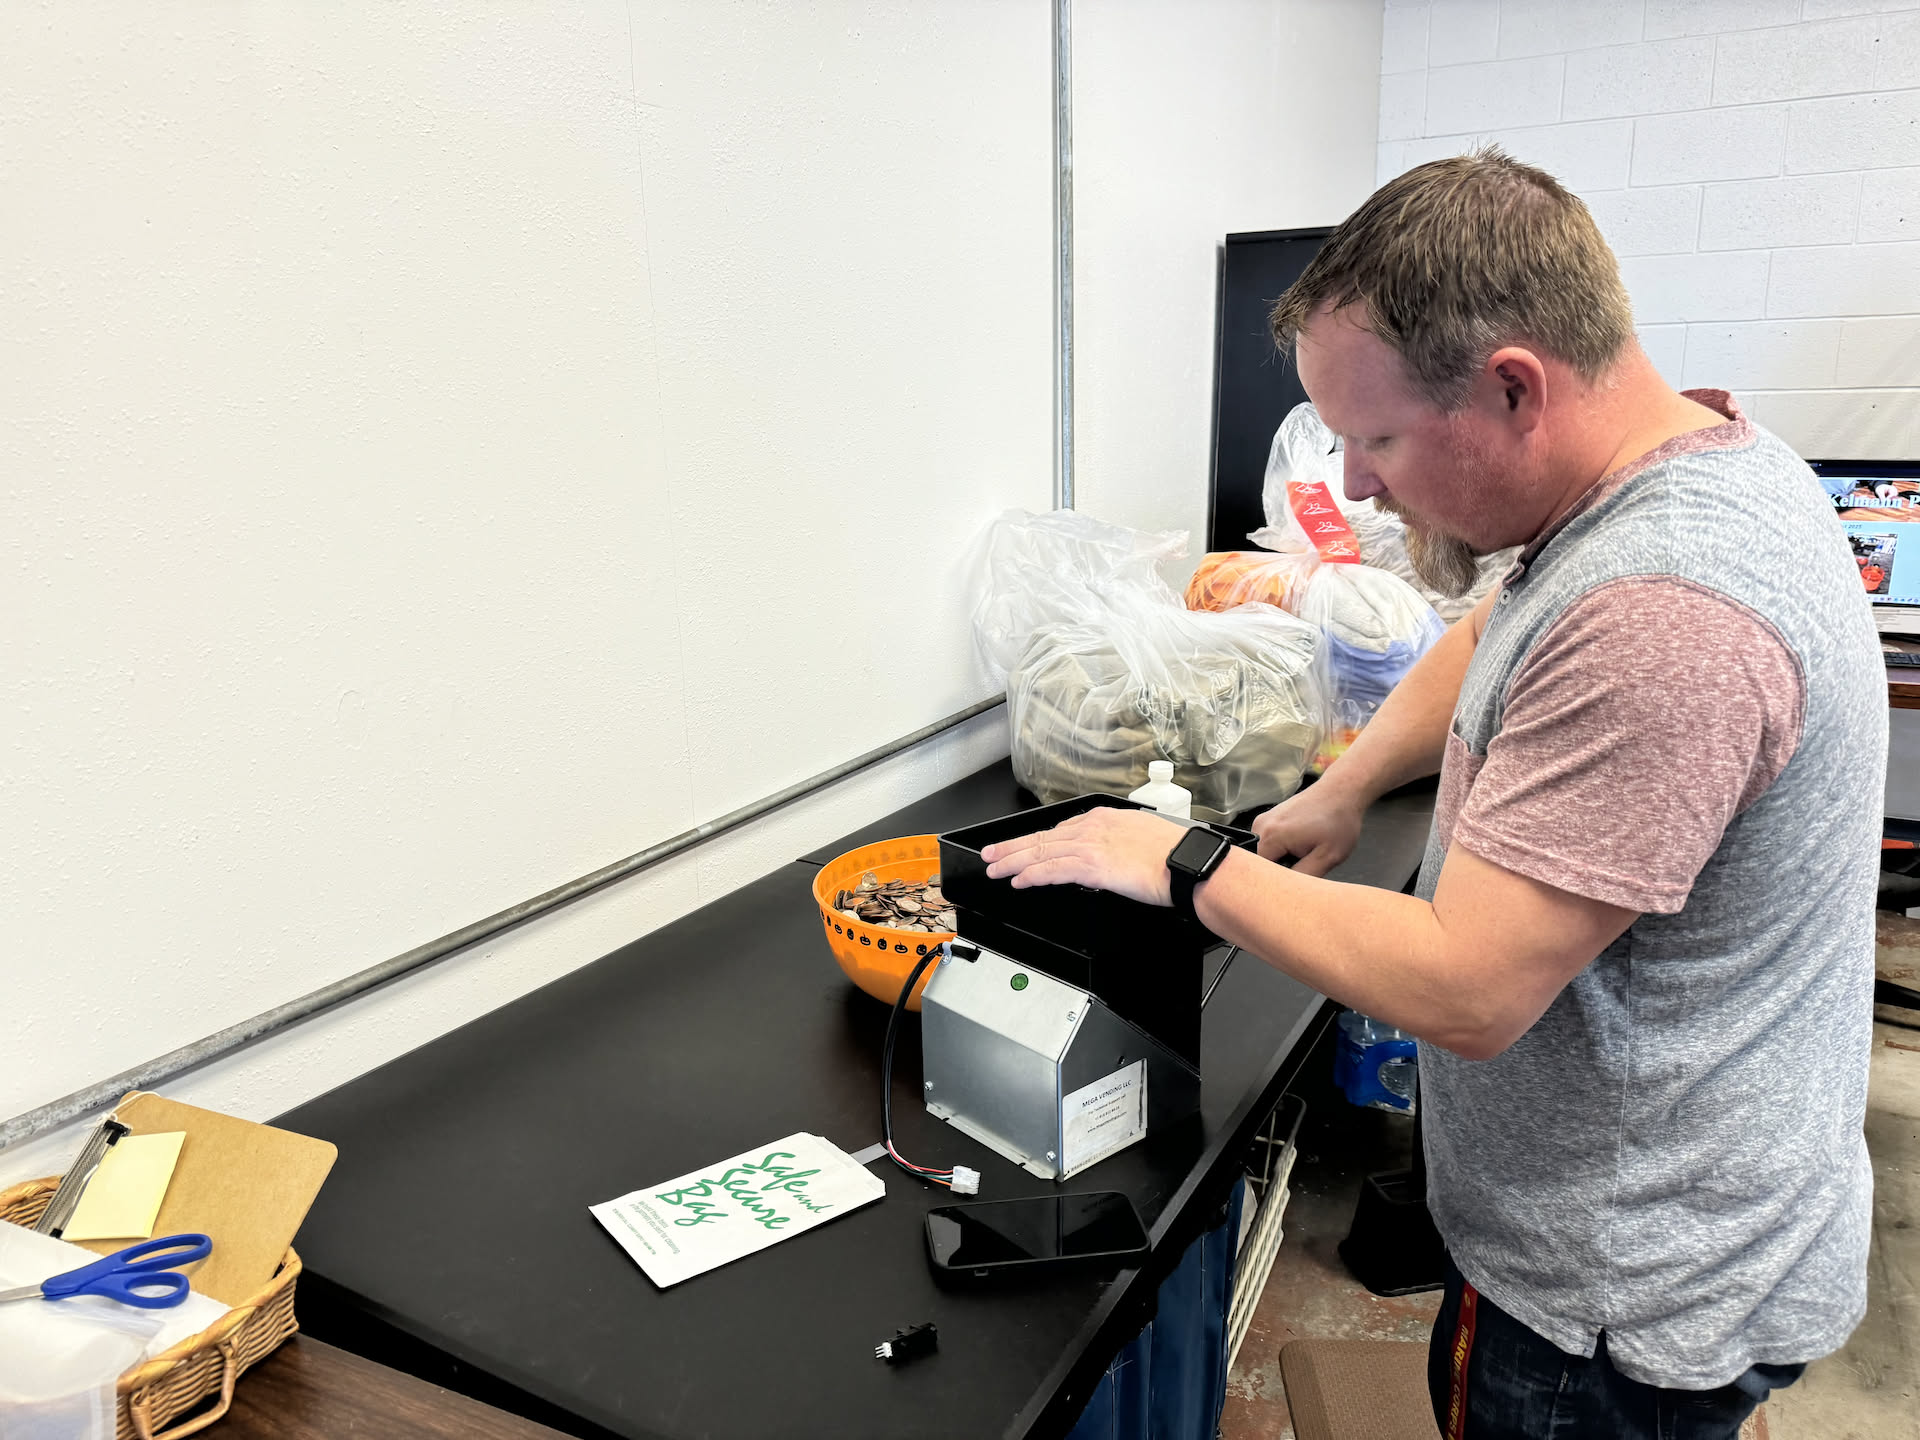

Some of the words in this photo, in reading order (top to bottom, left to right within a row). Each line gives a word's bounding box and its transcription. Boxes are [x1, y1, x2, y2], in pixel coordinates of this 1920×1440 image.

[1828, 493, 1903, 508] Kelmann
[1082, 1096, 1098, 1108] MEGA
[1099, 1083, 1122, 1099] VENDING
[1122, 1079, 1132, 1088] LLC
[655, 1182, 729, 1227] Bag
[700, 1168, 791, 1230] Secure
[742, 1152, 821, 1191] Safe
[793, 1194, 834, 1214] and
[1449, 1383, 1461, 1435] CORPS
